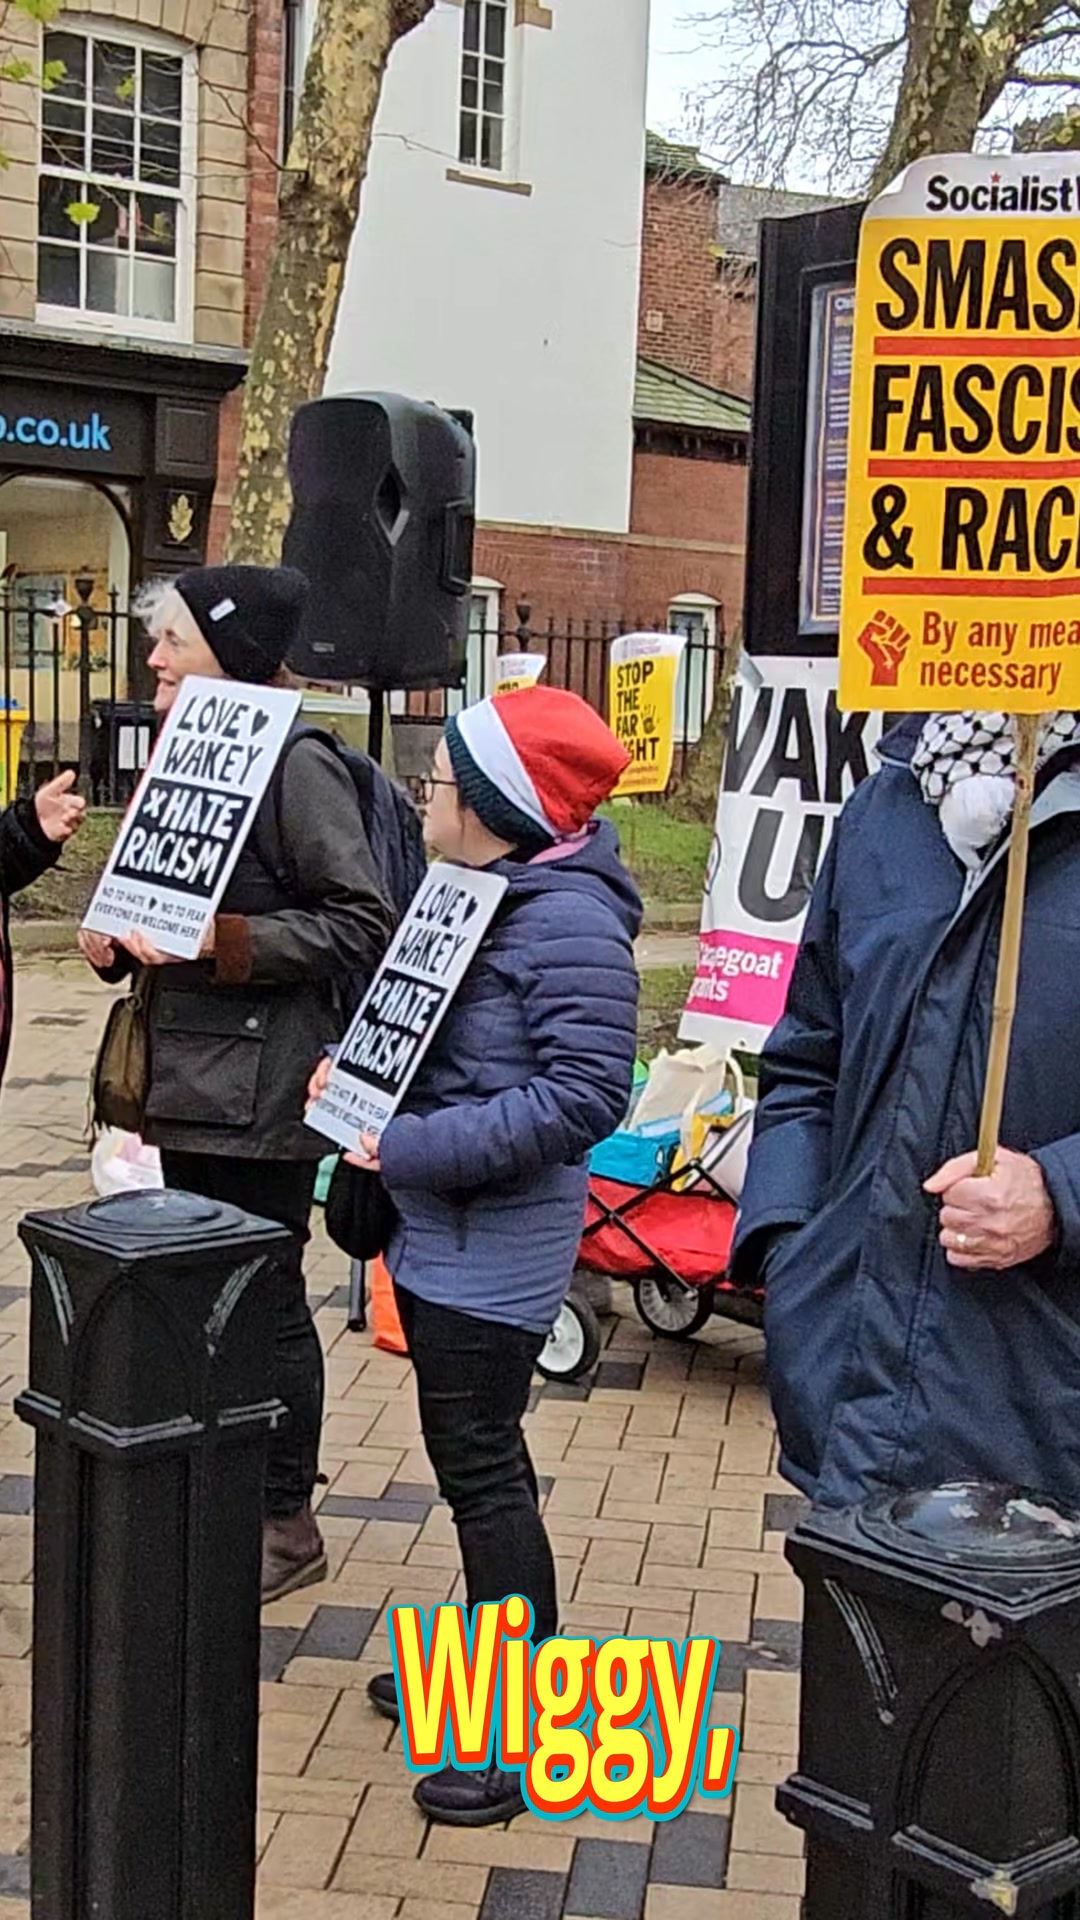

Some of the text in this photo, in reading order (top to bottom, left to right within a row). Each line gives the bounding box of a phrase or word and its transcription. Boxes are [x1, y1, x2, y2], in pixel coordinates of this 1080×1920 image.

[926, 172, 1073, 211] Socialist
[875, 238, 1080, 332] SMAS
[863, 484, 913, 571] &
[940, 485, 1080, 573] RAC
[922, 611, 957, 654] By
[968, 620, 1018, 656] any
[617, 660, 654, 688] STOP
[920, 660, 1062, 696] necessary
[177, 695, 250, 739] LOVE
[616, 688, 640, 713] THE
[616, 714, 638, 739] FAR
[162, 736, 263, 785] WAKEY
[119, 826, 223, 887] RACISM
[414, 882, 467, 928] LOVE
[393, 925, 469, 976] WAKEY
[342, 1018, 417, 1083] RACISM
